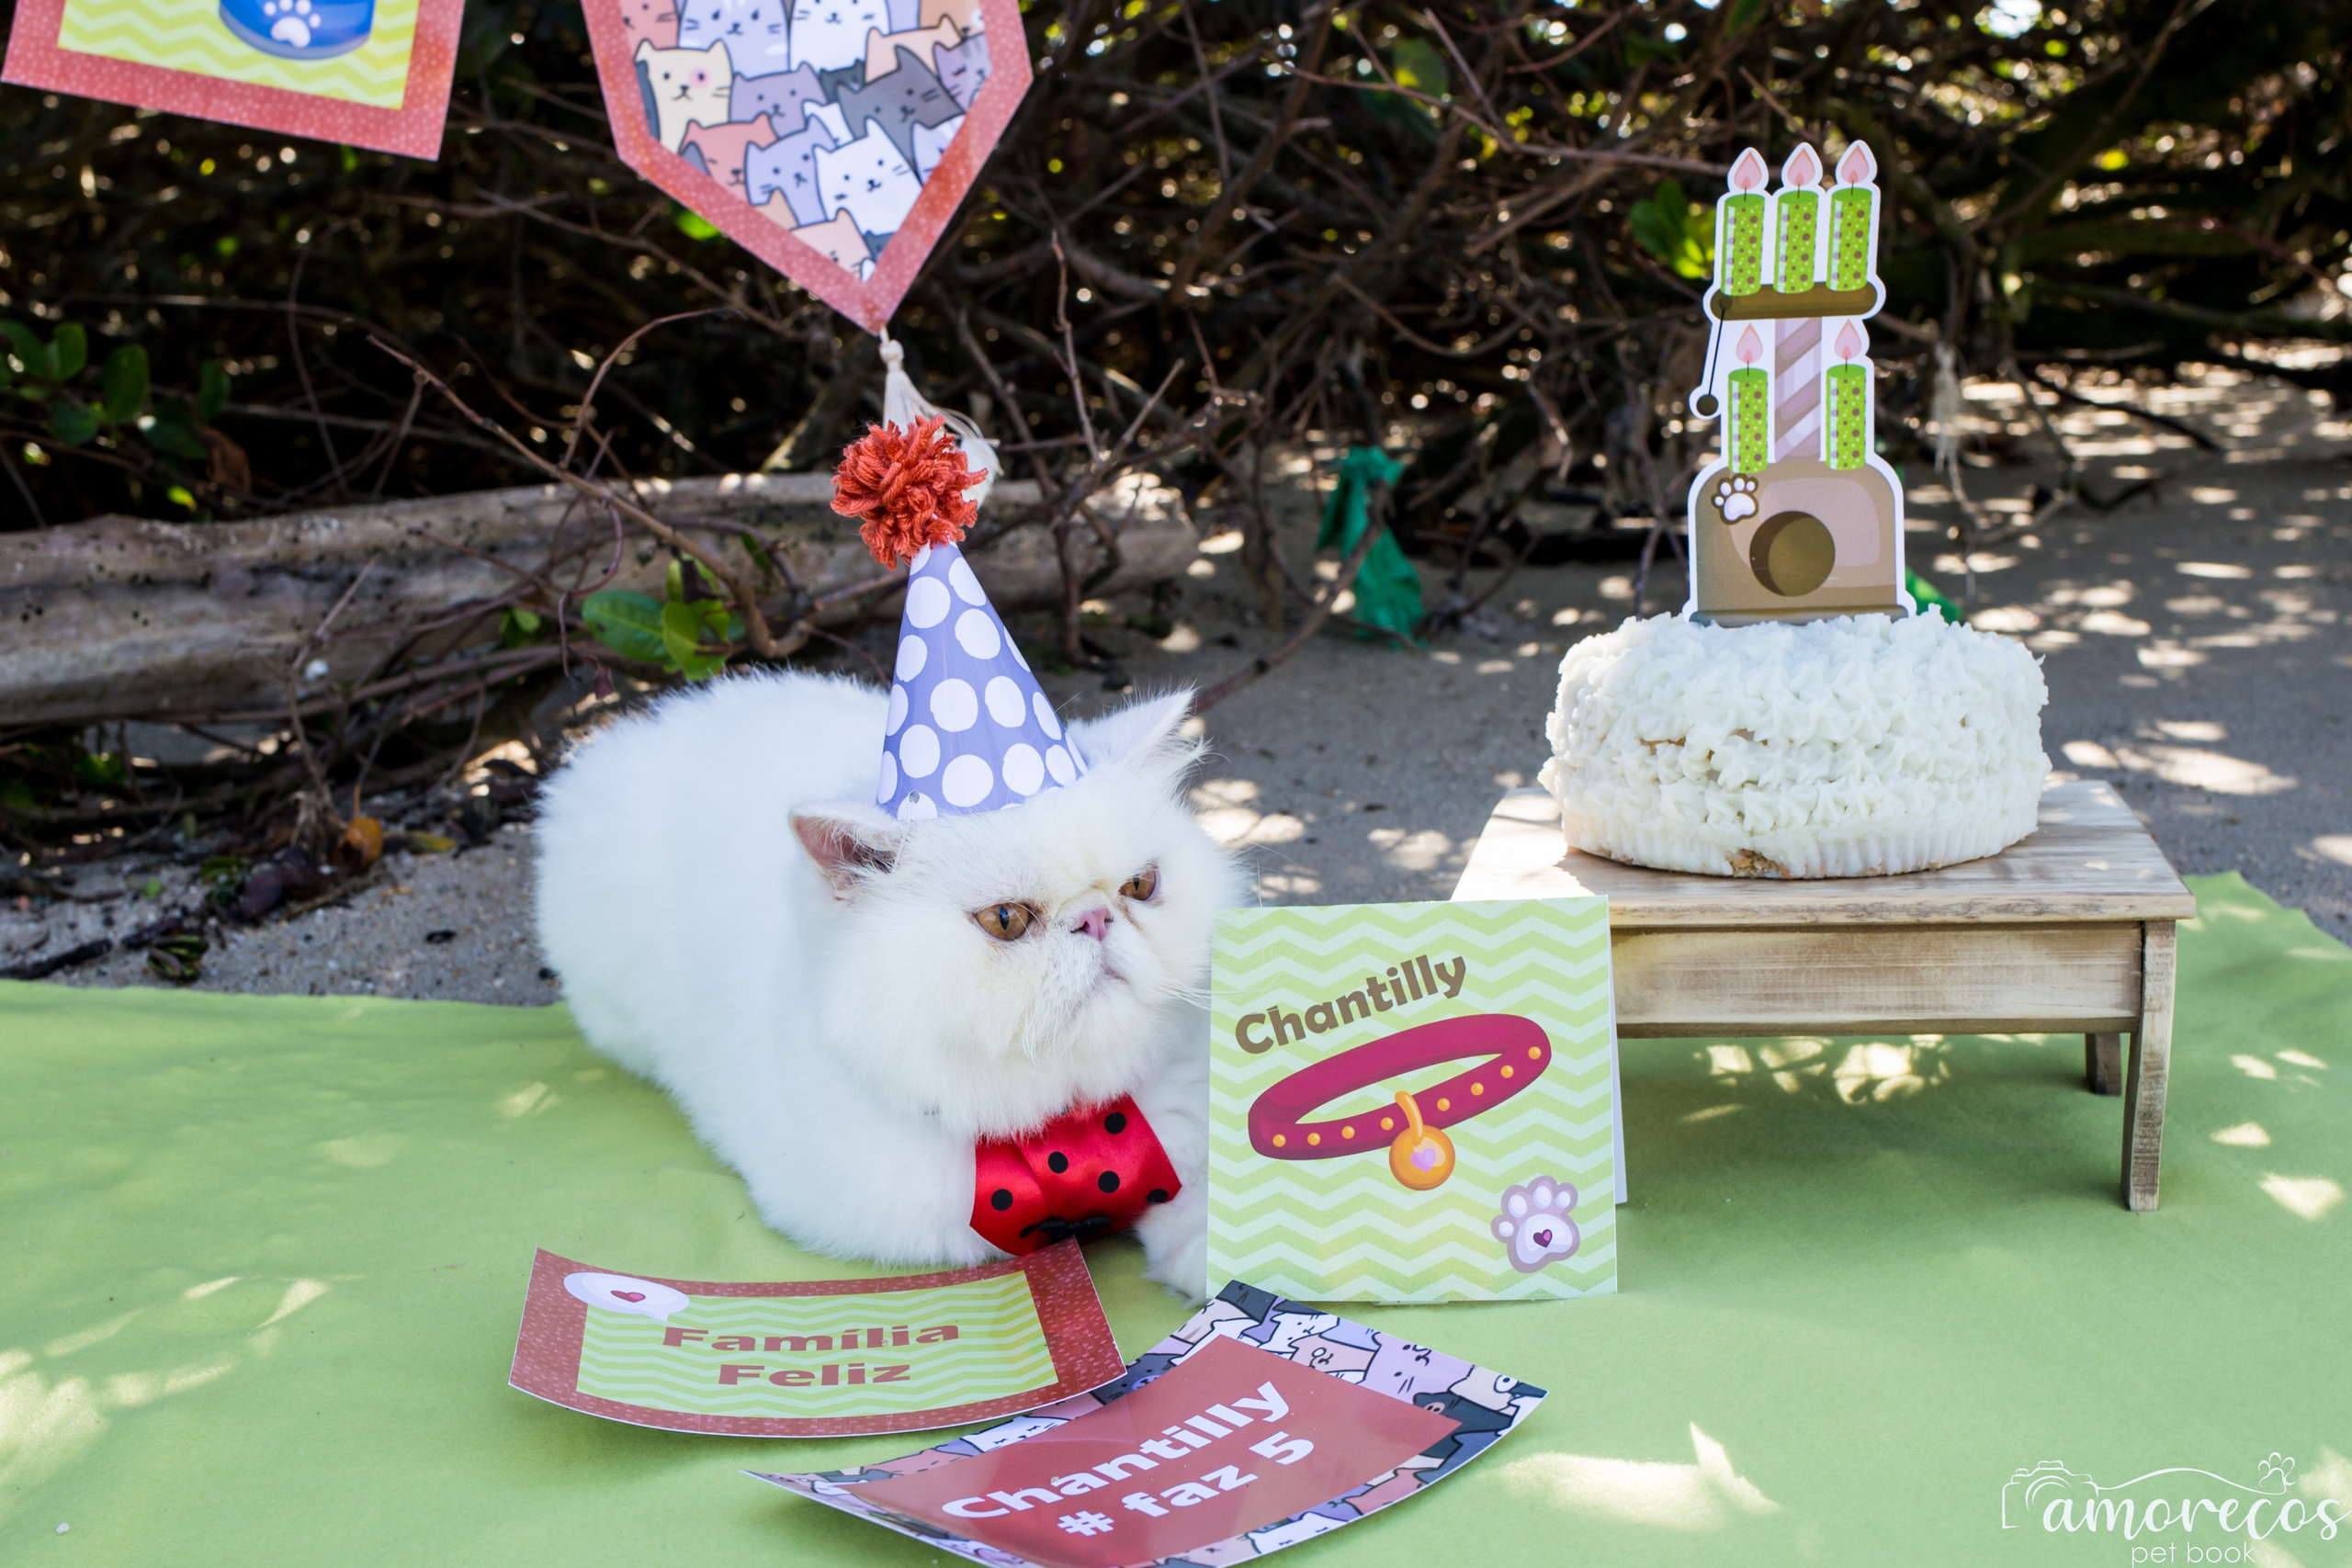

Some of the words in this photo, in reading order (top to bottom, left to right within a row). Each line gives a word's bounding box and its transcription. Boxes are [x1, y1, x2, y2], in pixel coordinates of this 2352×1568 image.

[1235, 954, 1466, 1054] Chantilly
[662, 1325, 959, 1351] Família
[718, 1362, 910, 1387] Feliz
[942, 1381, 1289, 1518] Chantilly
[1121, 1464, 1259, 1517] faz
[1249, 1430, 1315, 1465] 5
